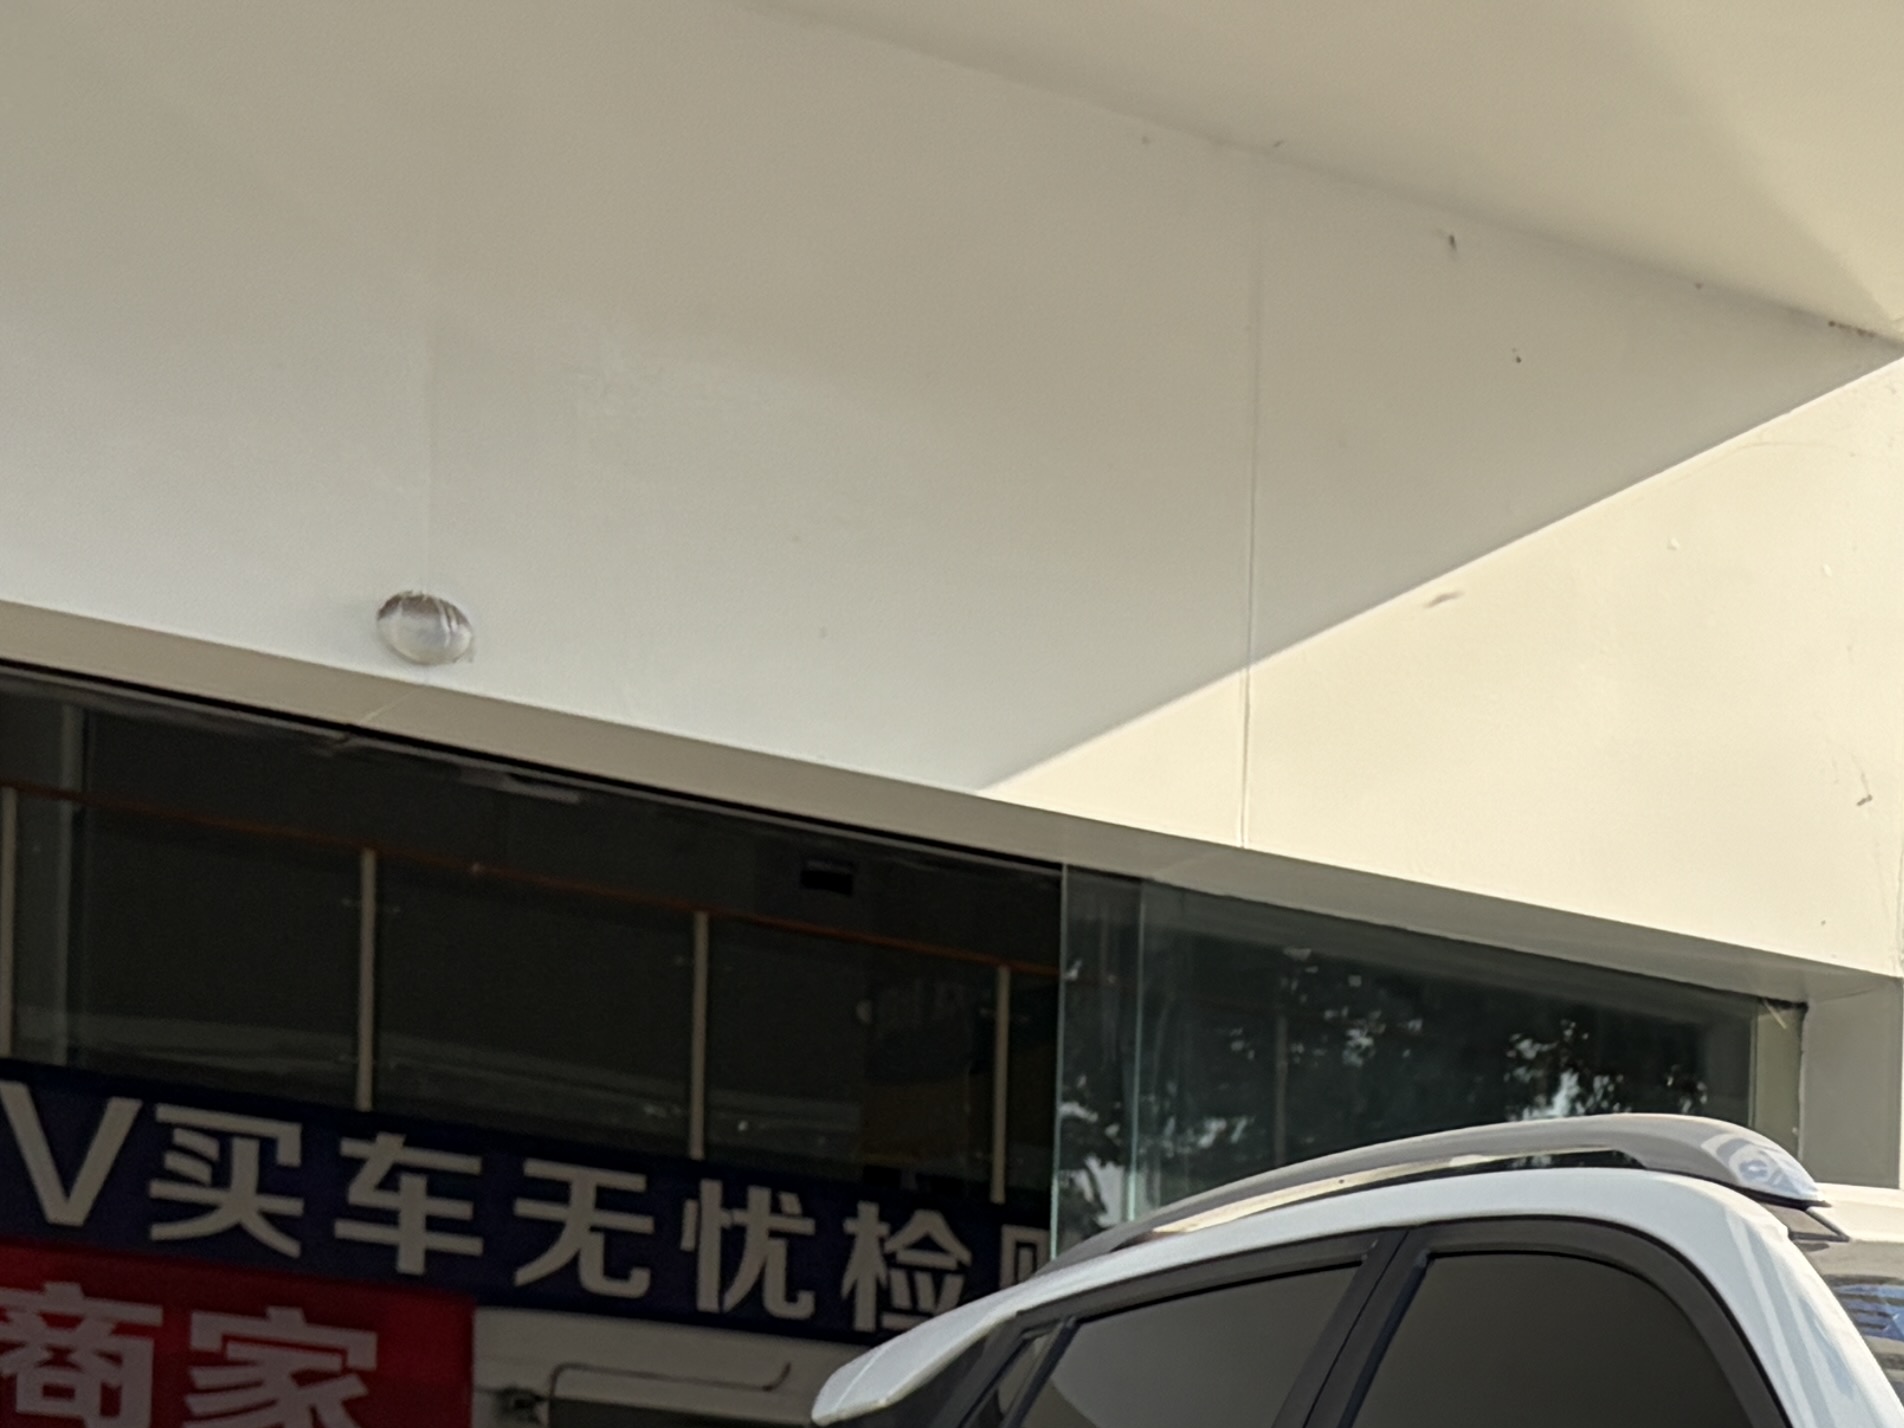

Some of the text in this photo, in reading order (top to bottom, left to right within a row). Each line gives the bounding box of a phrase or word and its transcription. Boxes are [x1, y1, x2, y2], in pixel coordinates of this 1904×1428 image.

[0, 1080, 1051, 1333] V买车无忧检
